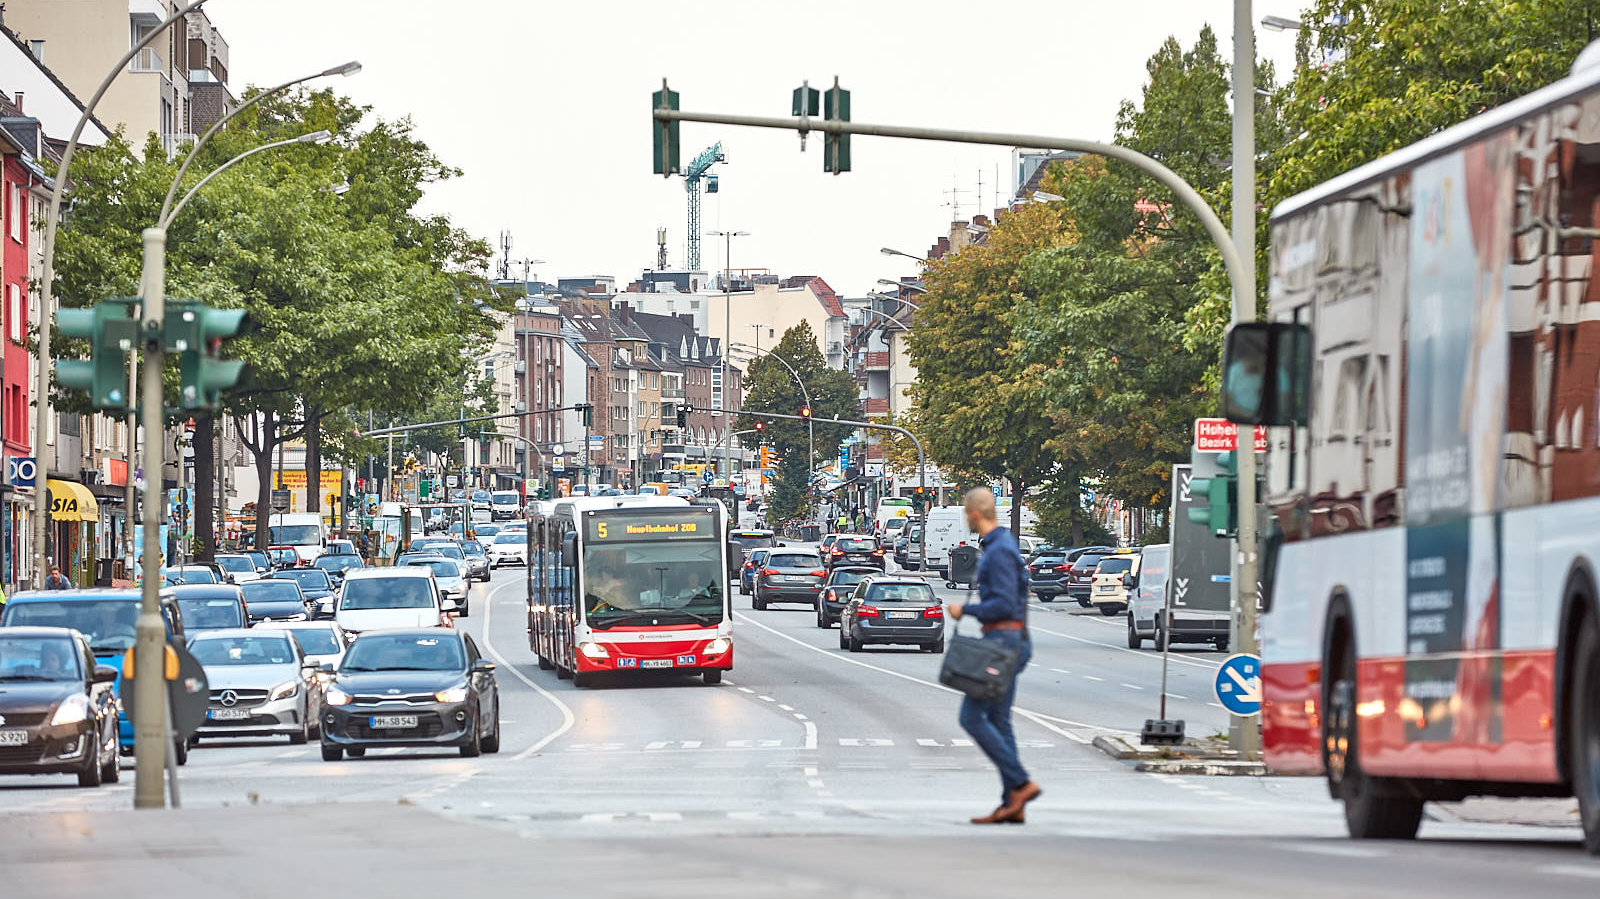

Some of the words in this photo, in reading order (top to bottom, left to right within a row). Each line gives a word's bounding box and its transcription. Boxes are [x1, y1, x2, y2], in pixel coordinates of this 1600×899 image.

[1200, 437, 1233, 448] Bezirk
[52, 499, 78, 513] SIA
[598, 522, 608, 538] 5
[626, 524, 678, 534] Hauptbahnhof
[8, 732, 26, 742] 920
